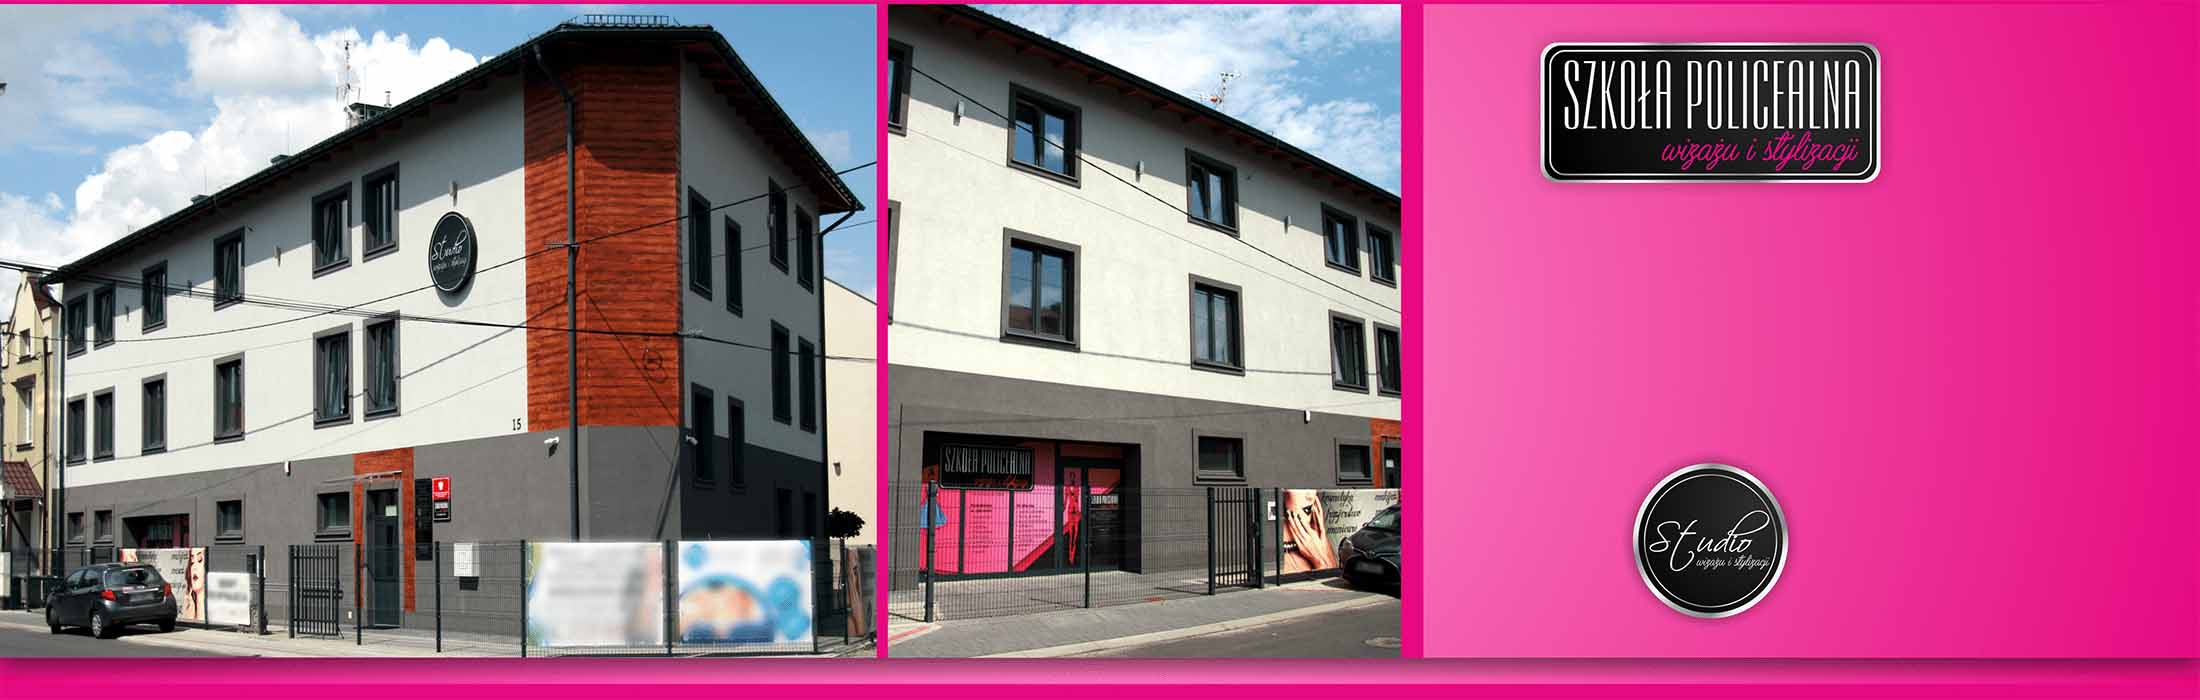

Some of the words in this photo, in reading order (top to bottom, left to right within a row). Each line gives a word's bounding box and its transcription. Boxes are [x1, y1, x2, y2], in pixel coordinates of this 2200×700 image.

[512, 418, 522, 431] 15
[944, 447, 979, 473] SZKOŁA
[981, 448, 1032, 476] POLICEALNA
